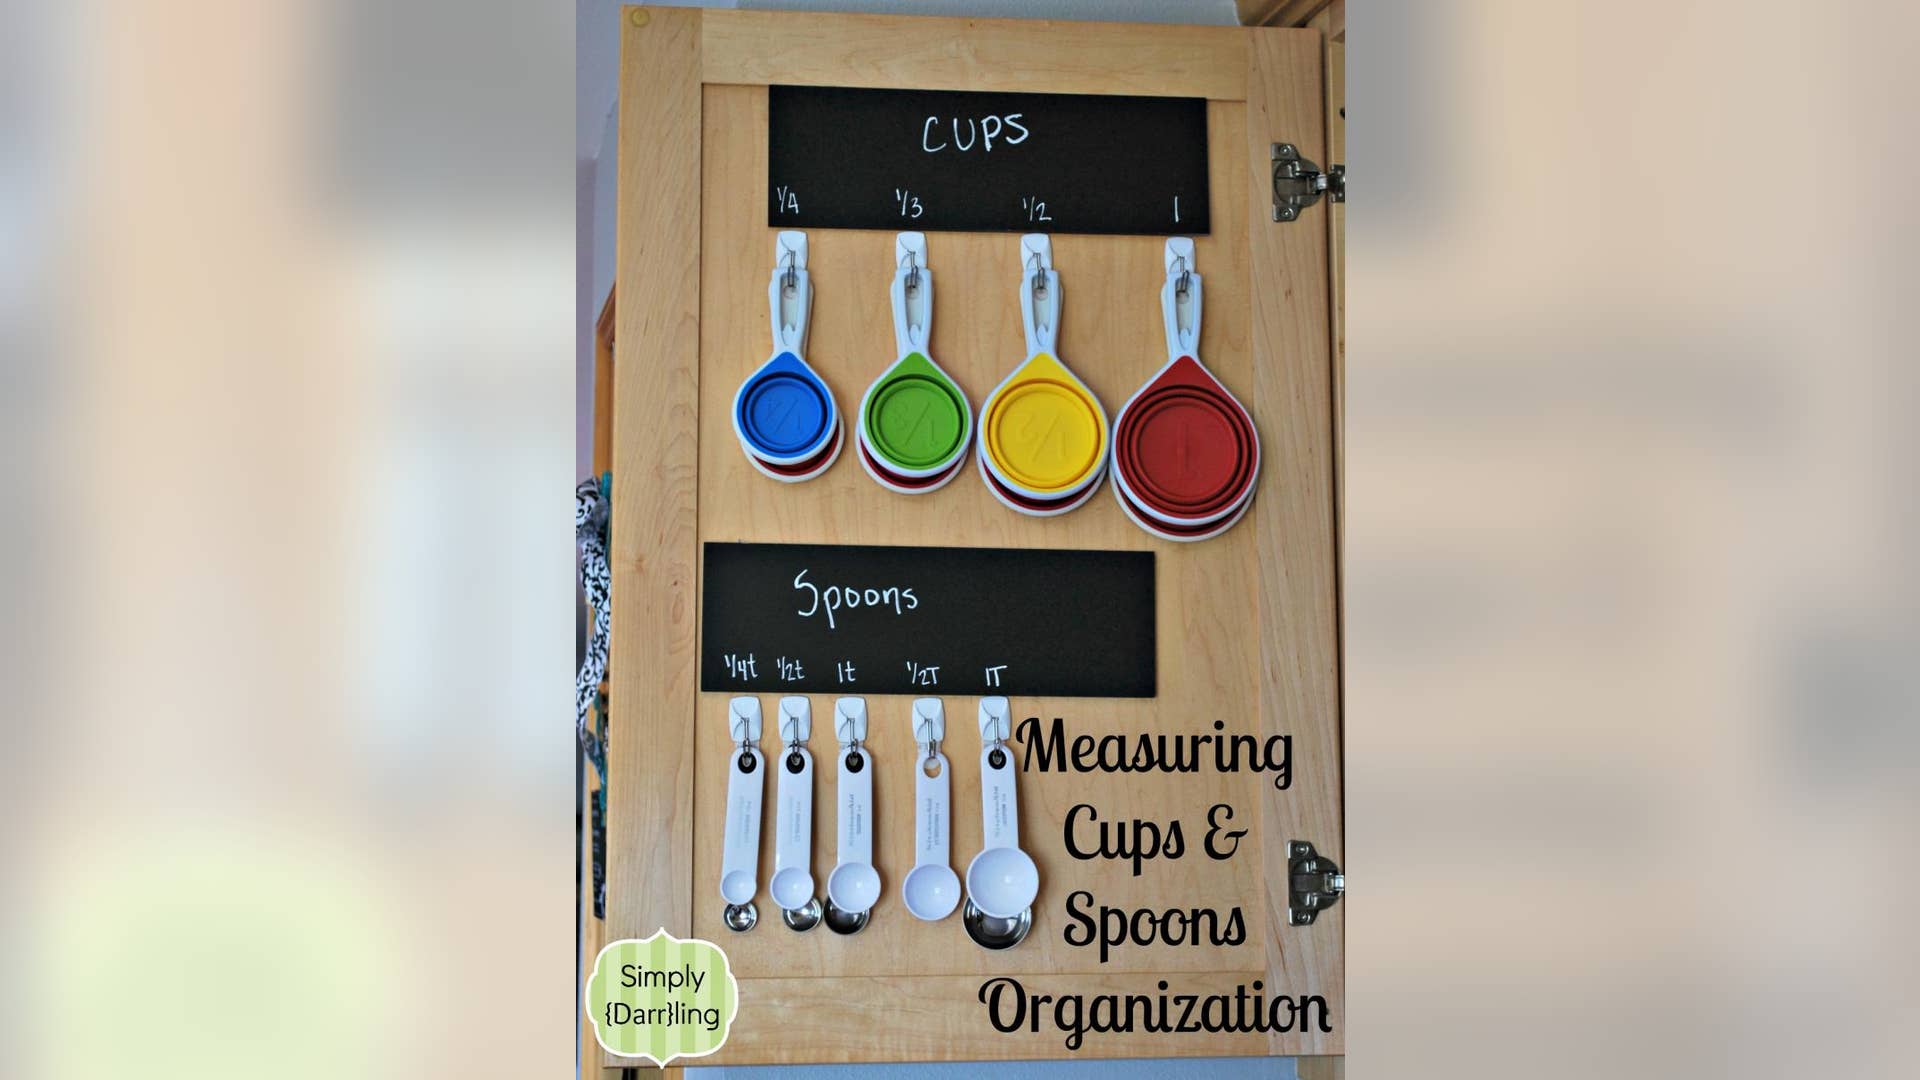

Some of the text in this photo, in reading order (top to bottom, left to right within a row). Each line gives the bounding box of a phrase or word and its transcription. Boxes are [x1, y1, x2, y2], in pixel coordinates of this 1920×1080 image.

[922, 113, 1029, 153] CUPS
[776, 185, 799, 214] 1/4
[895, 188, 923, 218] 1/3
[1022, 196, 1052, 221] 1/2
[793, 568, 919, 630] Spoons
[776, 655, 805, 682] 1/2t
[906, 661, 940, 686] 1/2T
